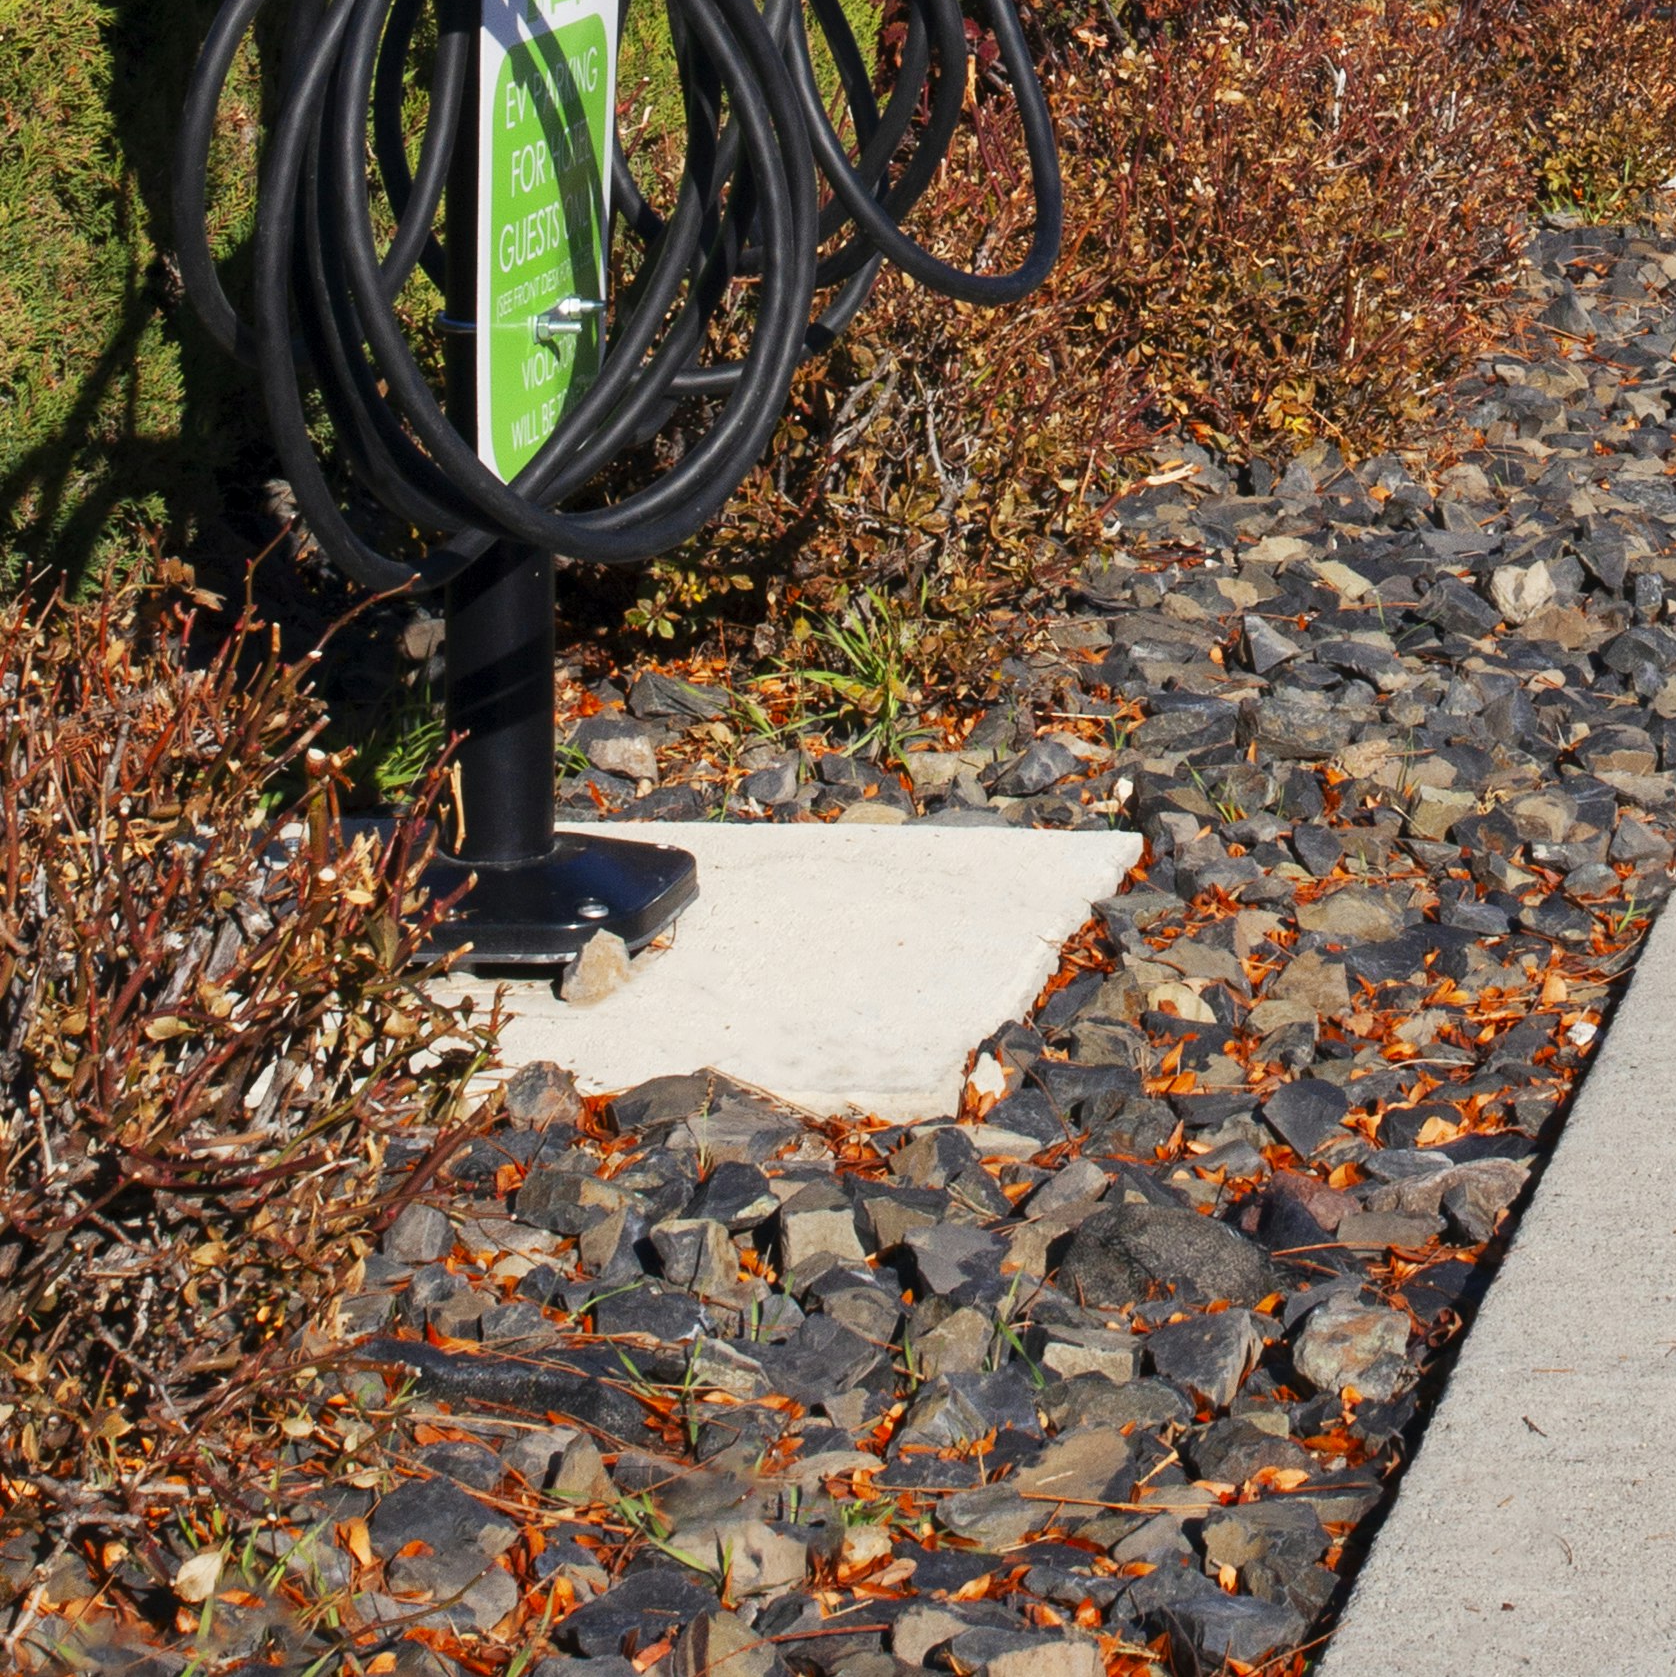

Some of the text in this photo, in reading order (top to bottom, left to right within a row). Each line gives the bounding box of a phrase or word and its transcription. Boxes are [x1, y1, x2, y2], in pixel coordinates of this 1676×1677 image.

[505, 46, 599, 130] EV PARKING
[511, 116, 592, 199] FOR HOTEL
[499, 200, 561, 273] GUESTS
[511, 408, 540, 452] WILL
[542, 398, 557, 435] BE
